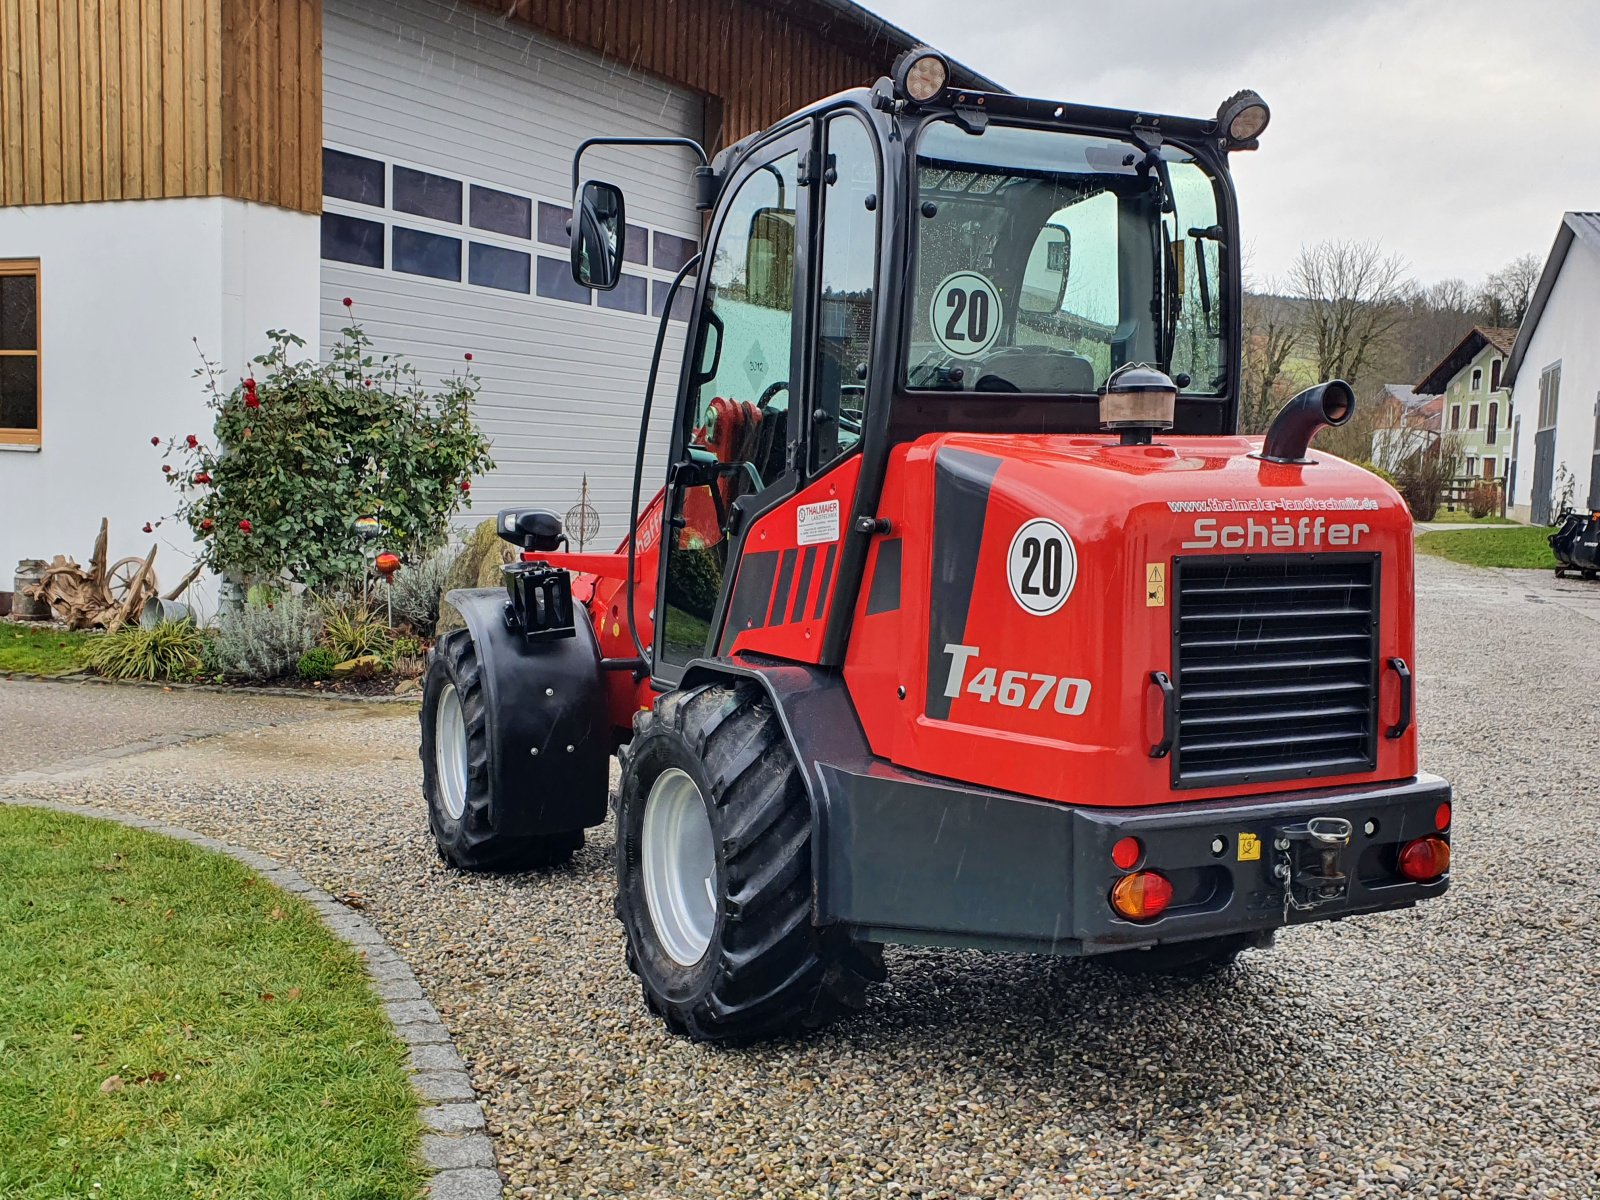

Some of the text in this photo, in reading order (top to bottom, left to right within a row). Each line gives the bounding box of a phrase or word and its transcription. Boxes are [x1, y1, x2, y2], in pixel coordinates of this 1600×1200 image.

[945, 288, 989, 342] 20
[806, 503, 838, 516] THALMAIER
[1167, 497, 1379, 512] www.thalmaier-landtechnik.de
[1182, 516, 1370, 549] Schäffer
[1021, 537, 1063, 598] 20
